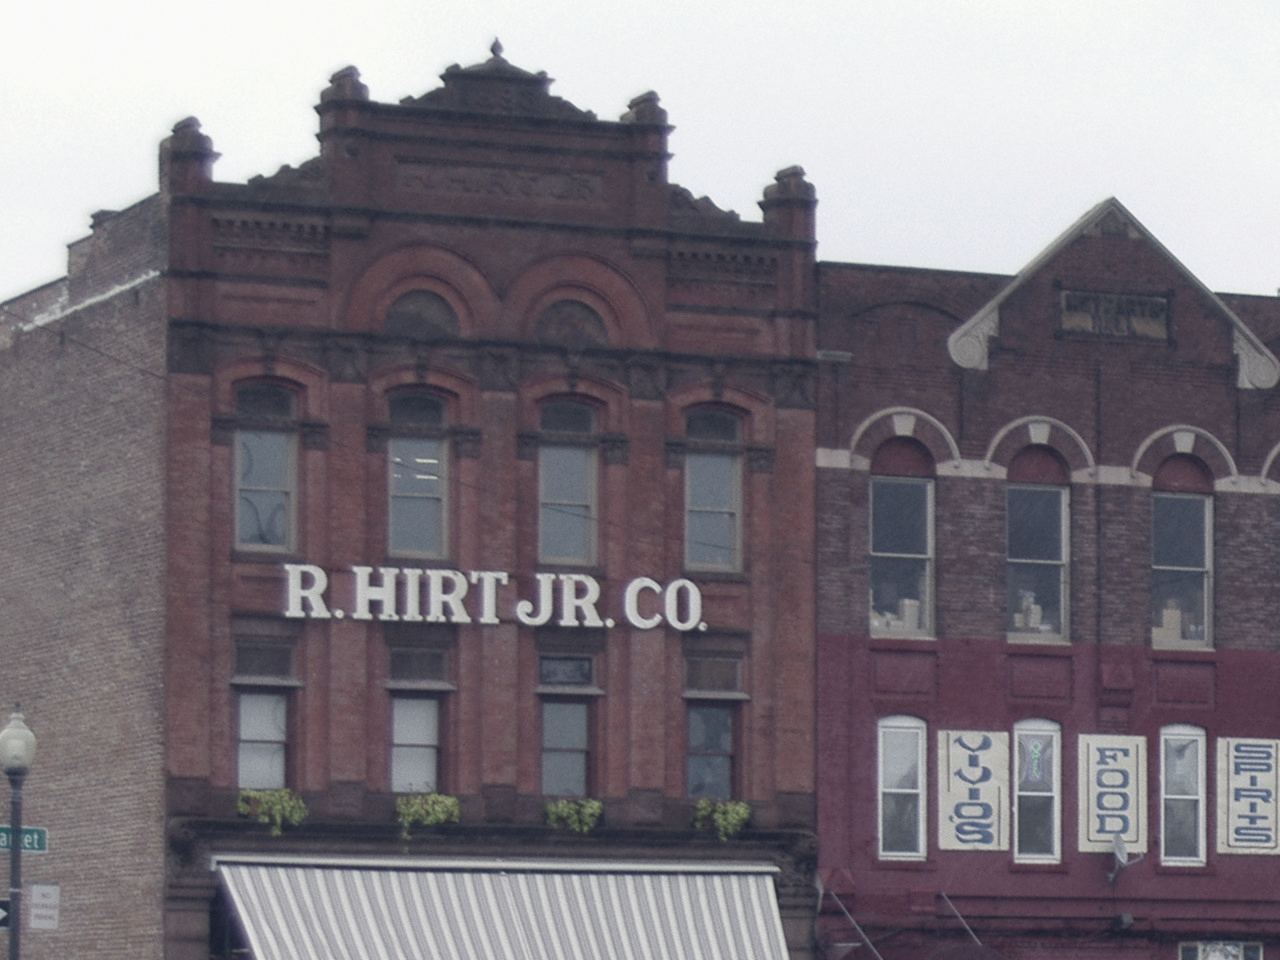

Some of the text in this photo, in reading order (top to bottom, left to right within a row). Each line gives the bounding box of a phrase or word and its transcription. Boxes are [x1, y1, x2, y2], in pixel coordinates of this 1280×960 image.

[284, 563, 709, 632] R. HIRT JR. CO.
[1096, 747, 1130, 835] FOOD
[1233, 743, 1273, 844] SPIRITS
